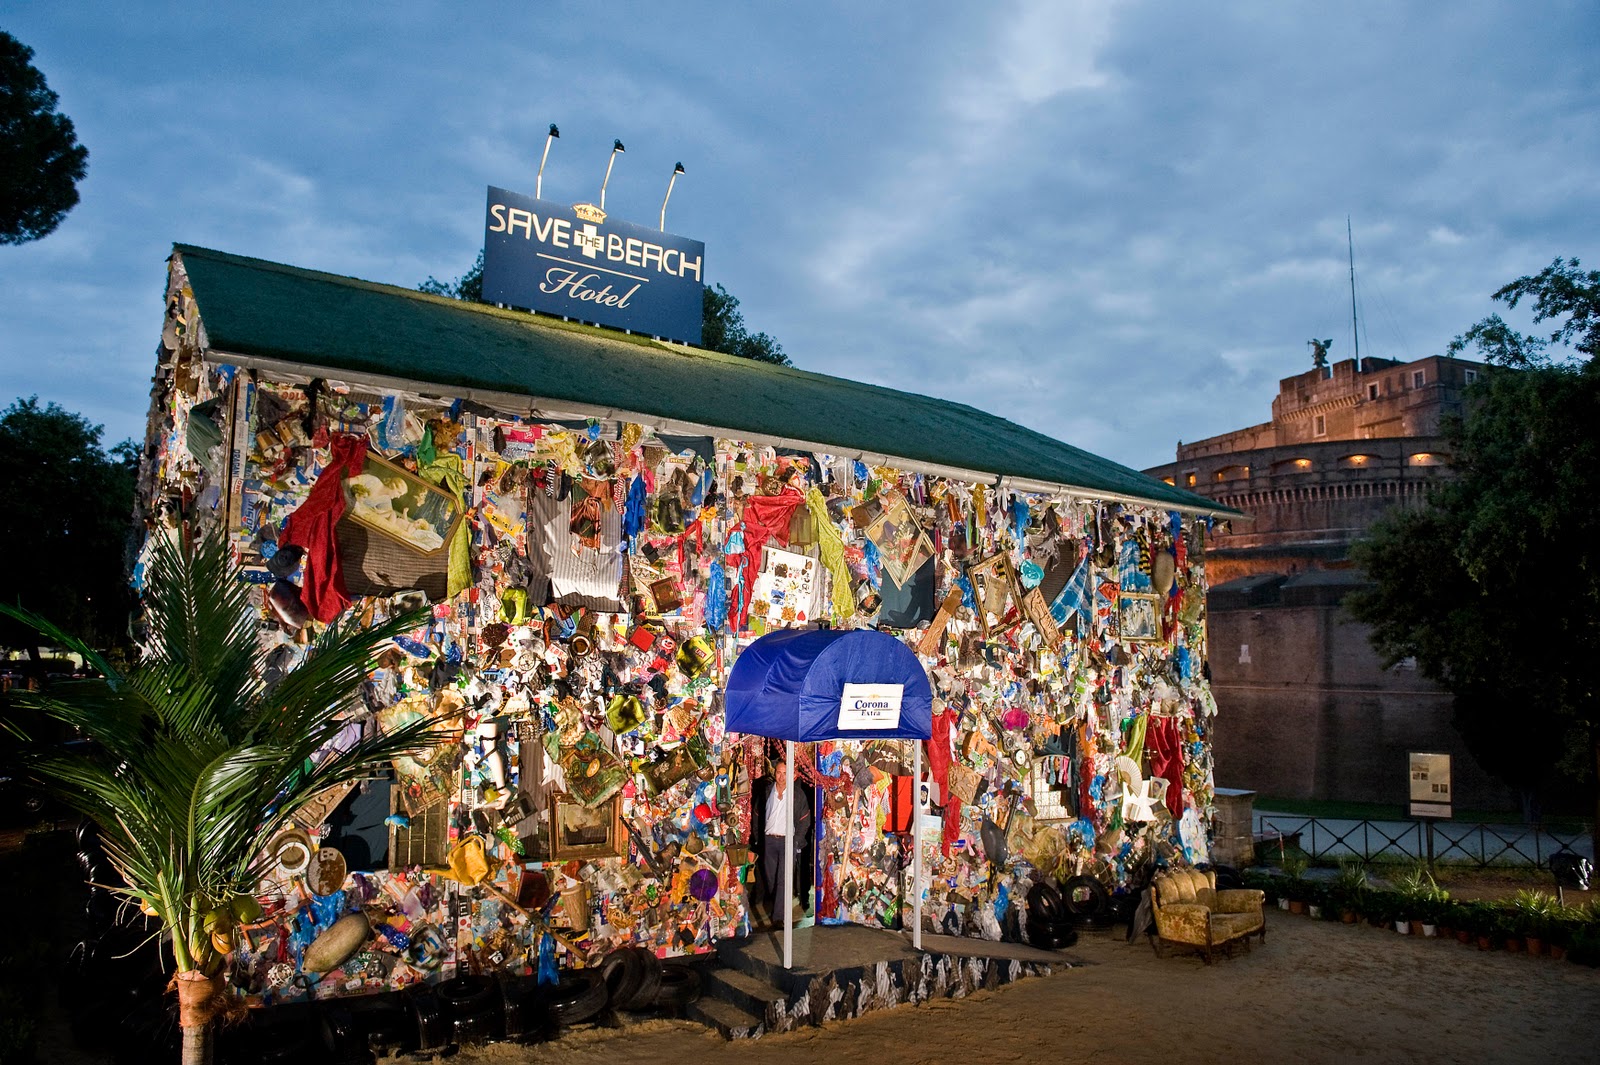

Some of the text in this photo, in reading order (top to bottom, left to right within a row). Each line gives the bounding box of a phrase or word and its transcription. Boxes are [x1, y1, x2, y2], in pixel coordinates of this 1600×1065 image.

[489, 204, 702, 283] SAVE THE BEACH
[539, 267, 642, 310] Hotel
[855, 700, 889, 710] Corona
